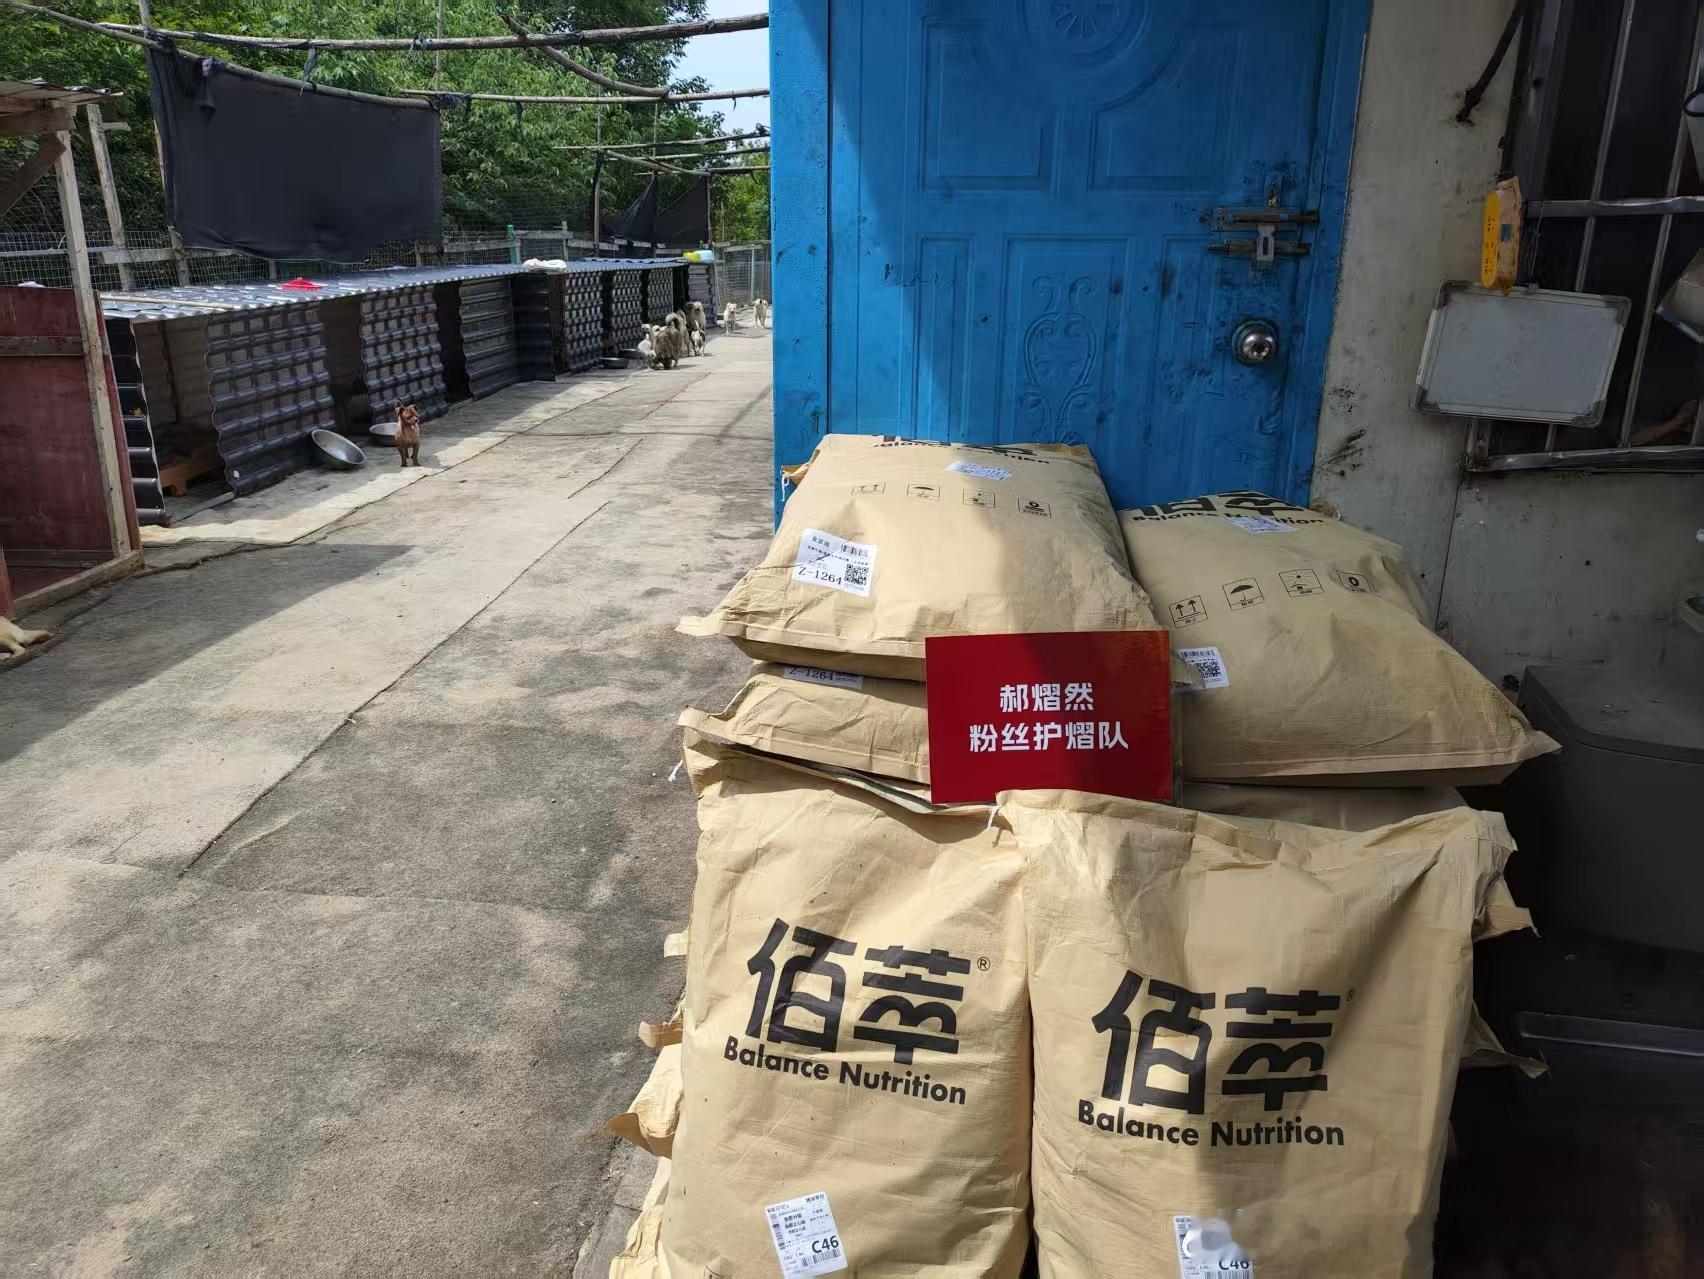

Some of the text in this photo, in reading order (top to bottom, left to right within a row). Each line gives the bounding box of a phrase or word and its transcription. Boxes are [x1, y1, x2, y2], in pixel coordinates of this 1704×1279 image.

[798, 566, 842, 585] Z-1264
[789, 667, 835, 682] Z-1264
[999, 682, 1095, 713] 郝熠然
[969, 721, 1129, 753] 粉丝护熠队
[723, 1036, 967, 1105] Balance Nutrition
[1078, 1099, 1345, 1147] Balance Nutrition
[811, 1235, 840, 1254] C46
